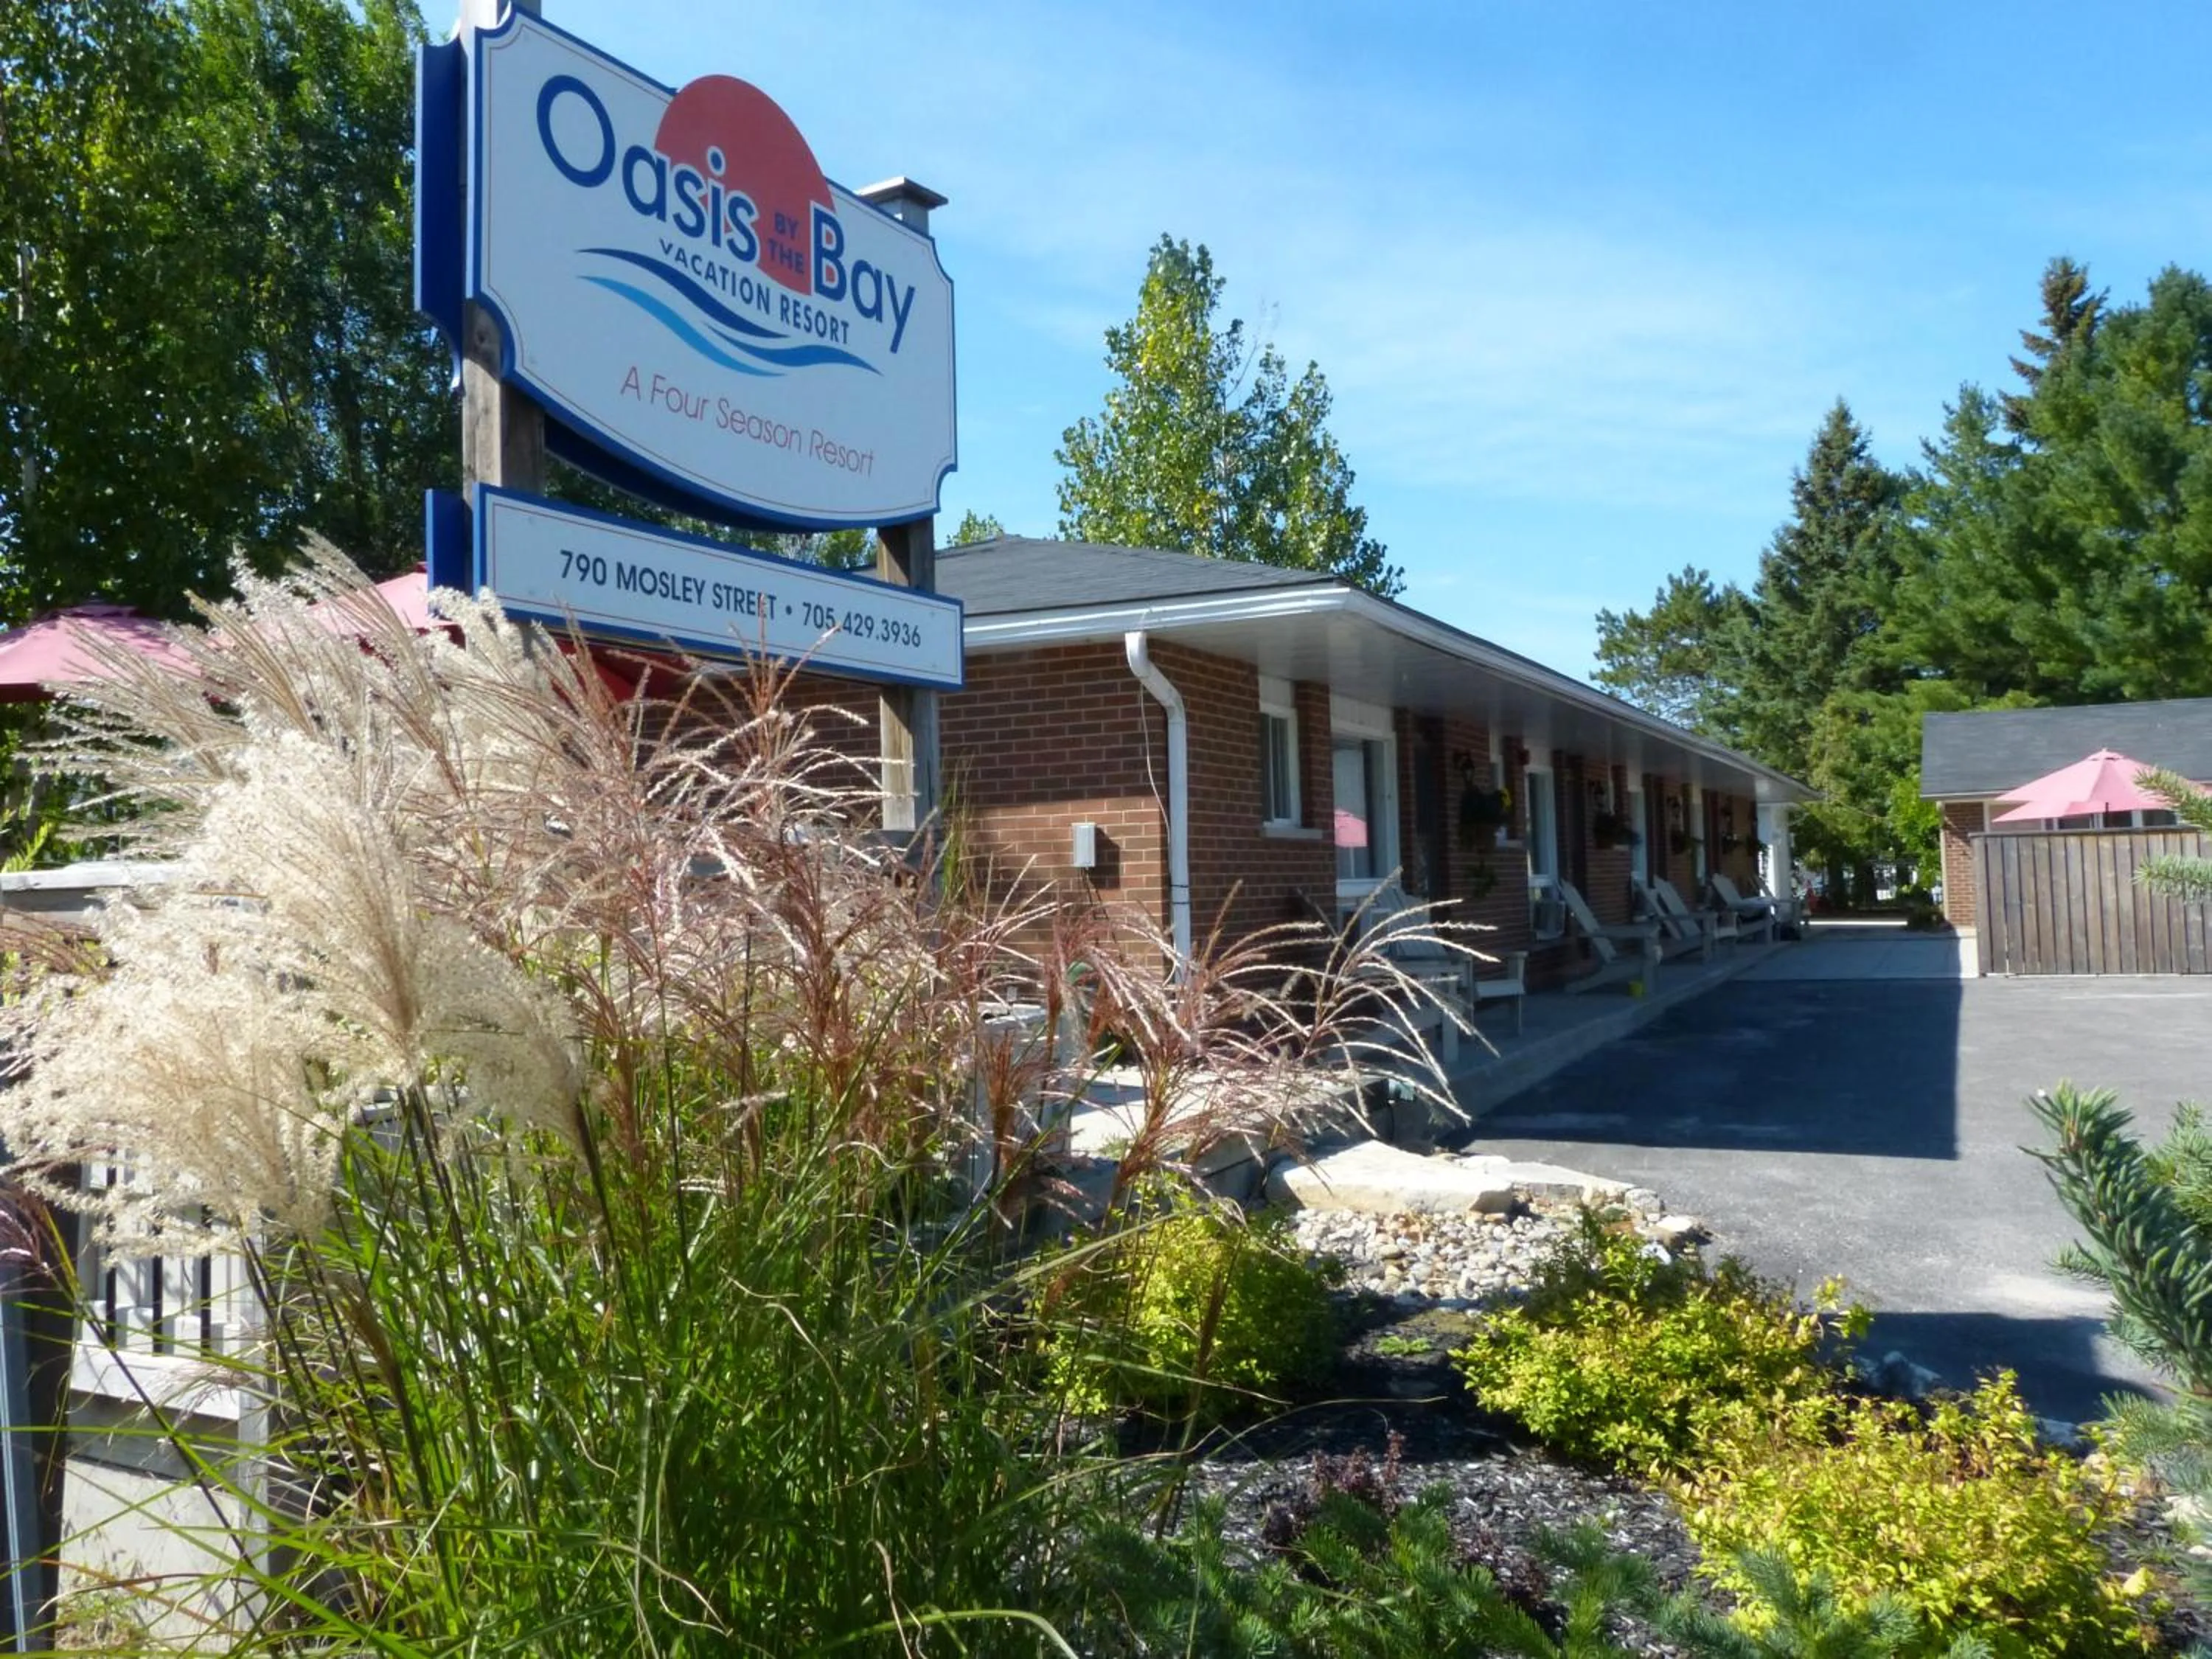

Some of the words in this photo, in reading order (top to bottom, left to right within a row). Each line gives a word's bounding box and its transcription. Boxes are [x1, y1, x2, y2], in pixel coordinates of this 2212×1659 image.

[536, 74, 759, 262] Oasis
[768, 240, 804, 275] THE
[775, 212, 799, 240] BY
[813, 206, 916, 353] Bay
[658, 237, 771, 315] VACATION
[779, 294, 851, 345] RESORT
[620, 366, 641, 401] A
[650, 375, 709, 420] Four
[717, 397, 802, 452] Season
[809, 428, 875, 476] Resort
[559, 549, 608, 586] 790
[616, 563, 706, 605] MOSLEY
[712, 582, 776, 620] STREET
